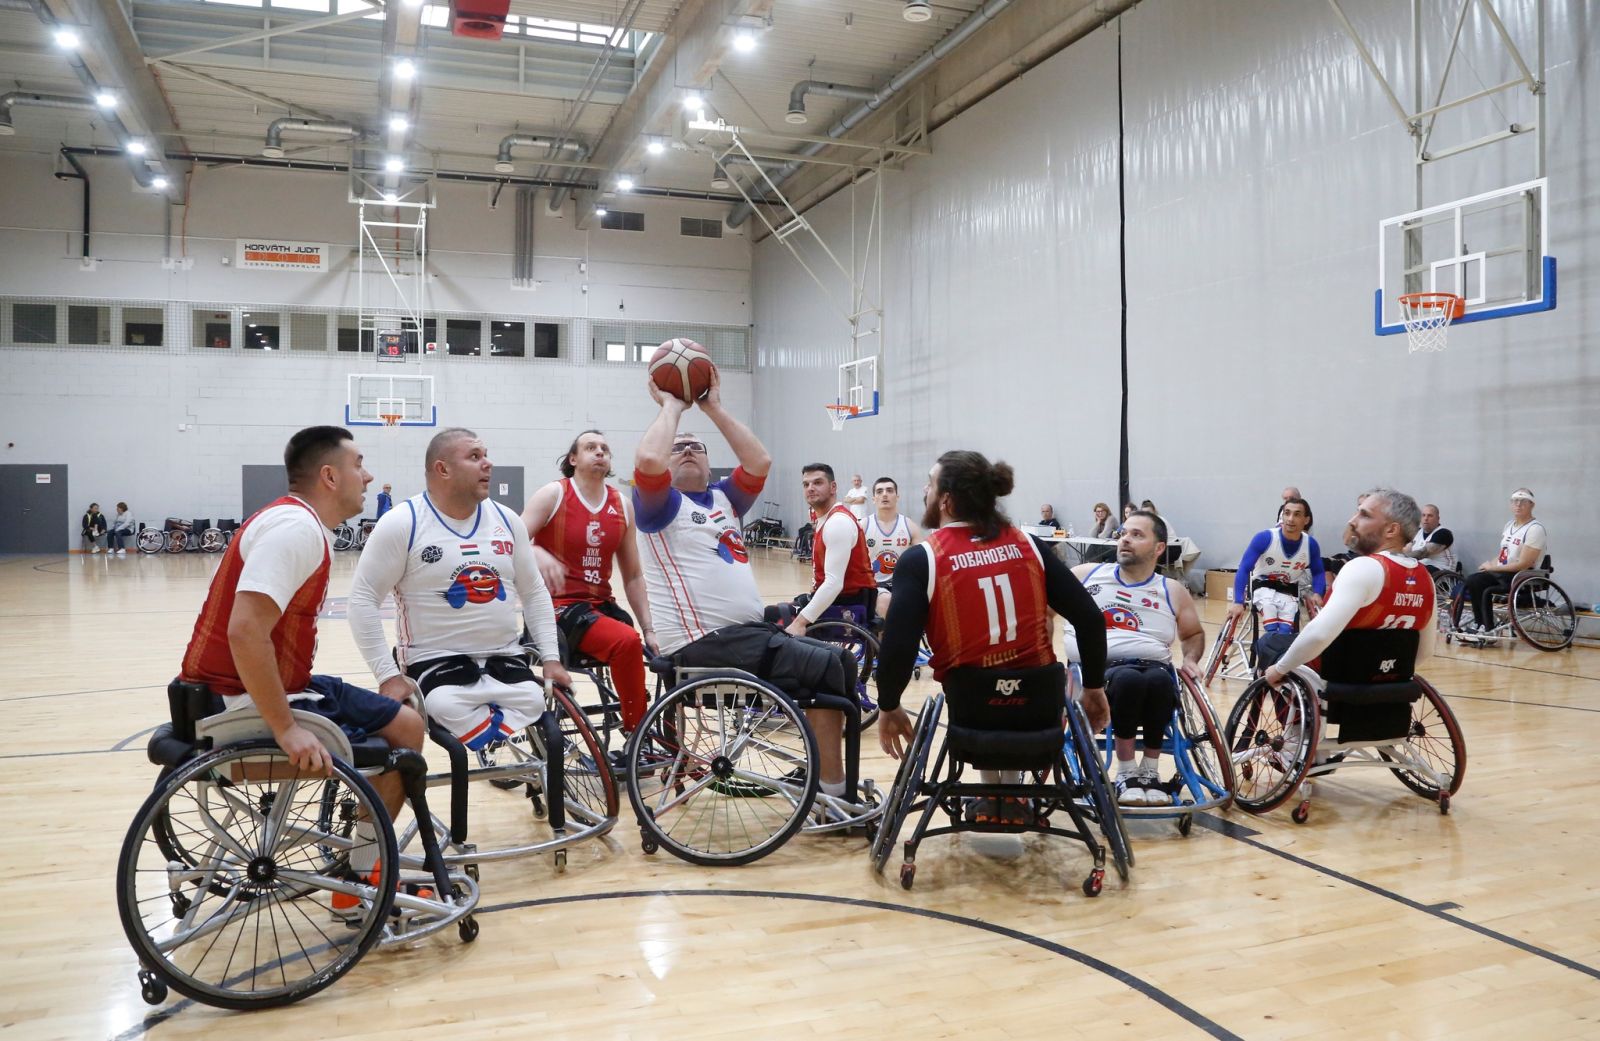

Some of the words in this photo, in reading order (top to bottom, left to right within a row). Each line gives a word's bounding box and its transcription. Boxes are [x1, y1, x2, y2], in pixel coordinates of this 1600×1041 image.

[294, 246, 320, 254] JUDIT
[491, 540, 513, 555] 30
[896, 538, 908, 546] 13
[949, 543, 1023, 571] ЈОВАНОВИЋ
[978, 573, 1018, 645] 11
